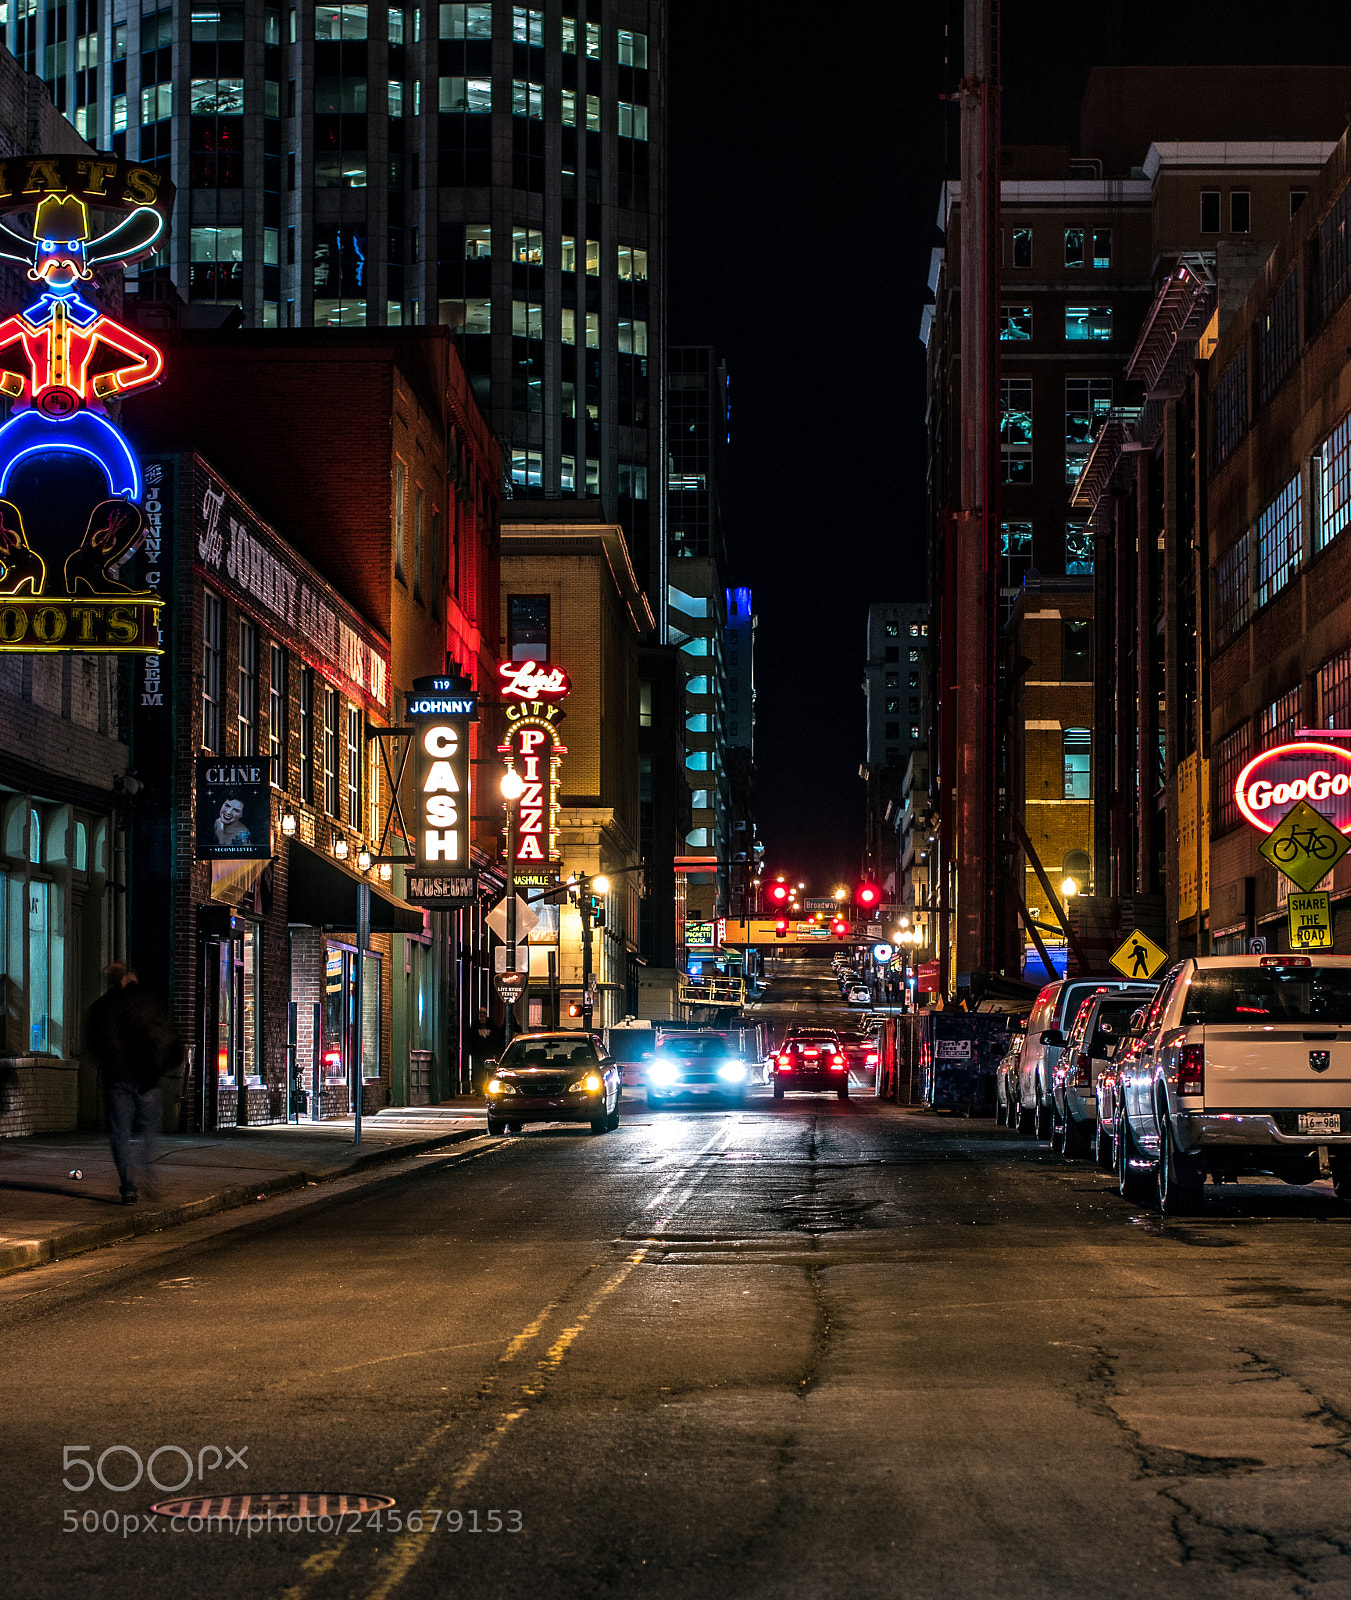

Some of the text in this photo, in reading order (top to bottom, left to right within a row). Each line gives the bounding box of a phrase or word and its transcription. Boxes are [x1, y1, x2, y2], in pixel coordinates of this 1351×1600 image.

[144, 487, 162, 564] JOHNNY
[198, 478, 225, 569] The
[227, 516, 297, 629] JOHNNY
[300, 583, 335, 665] CASH
[141, 630, 164, 706] SEUM
[433, 680, 450, 690] 119
[410, 700, 474, 714] JOHNNY
[506, 701, 559, 721] CITY
[205, 768, 261, 783] CLINE
[423, 726, 460, 861] CASH
[517, 730, 545, 859] PIZZA
[1247, 770, 1351, 810] GooGo
[411, 878, 474, 897] MUSEUM
[513, 875, 549, 886] NASHVILLE
[806, 901, 838, 910] Broadway
[1292, 898, 1326, 911] SHARE
[1300, 914, 1320, 925] THE
[1298, 929, 1325, 941] ROAD
